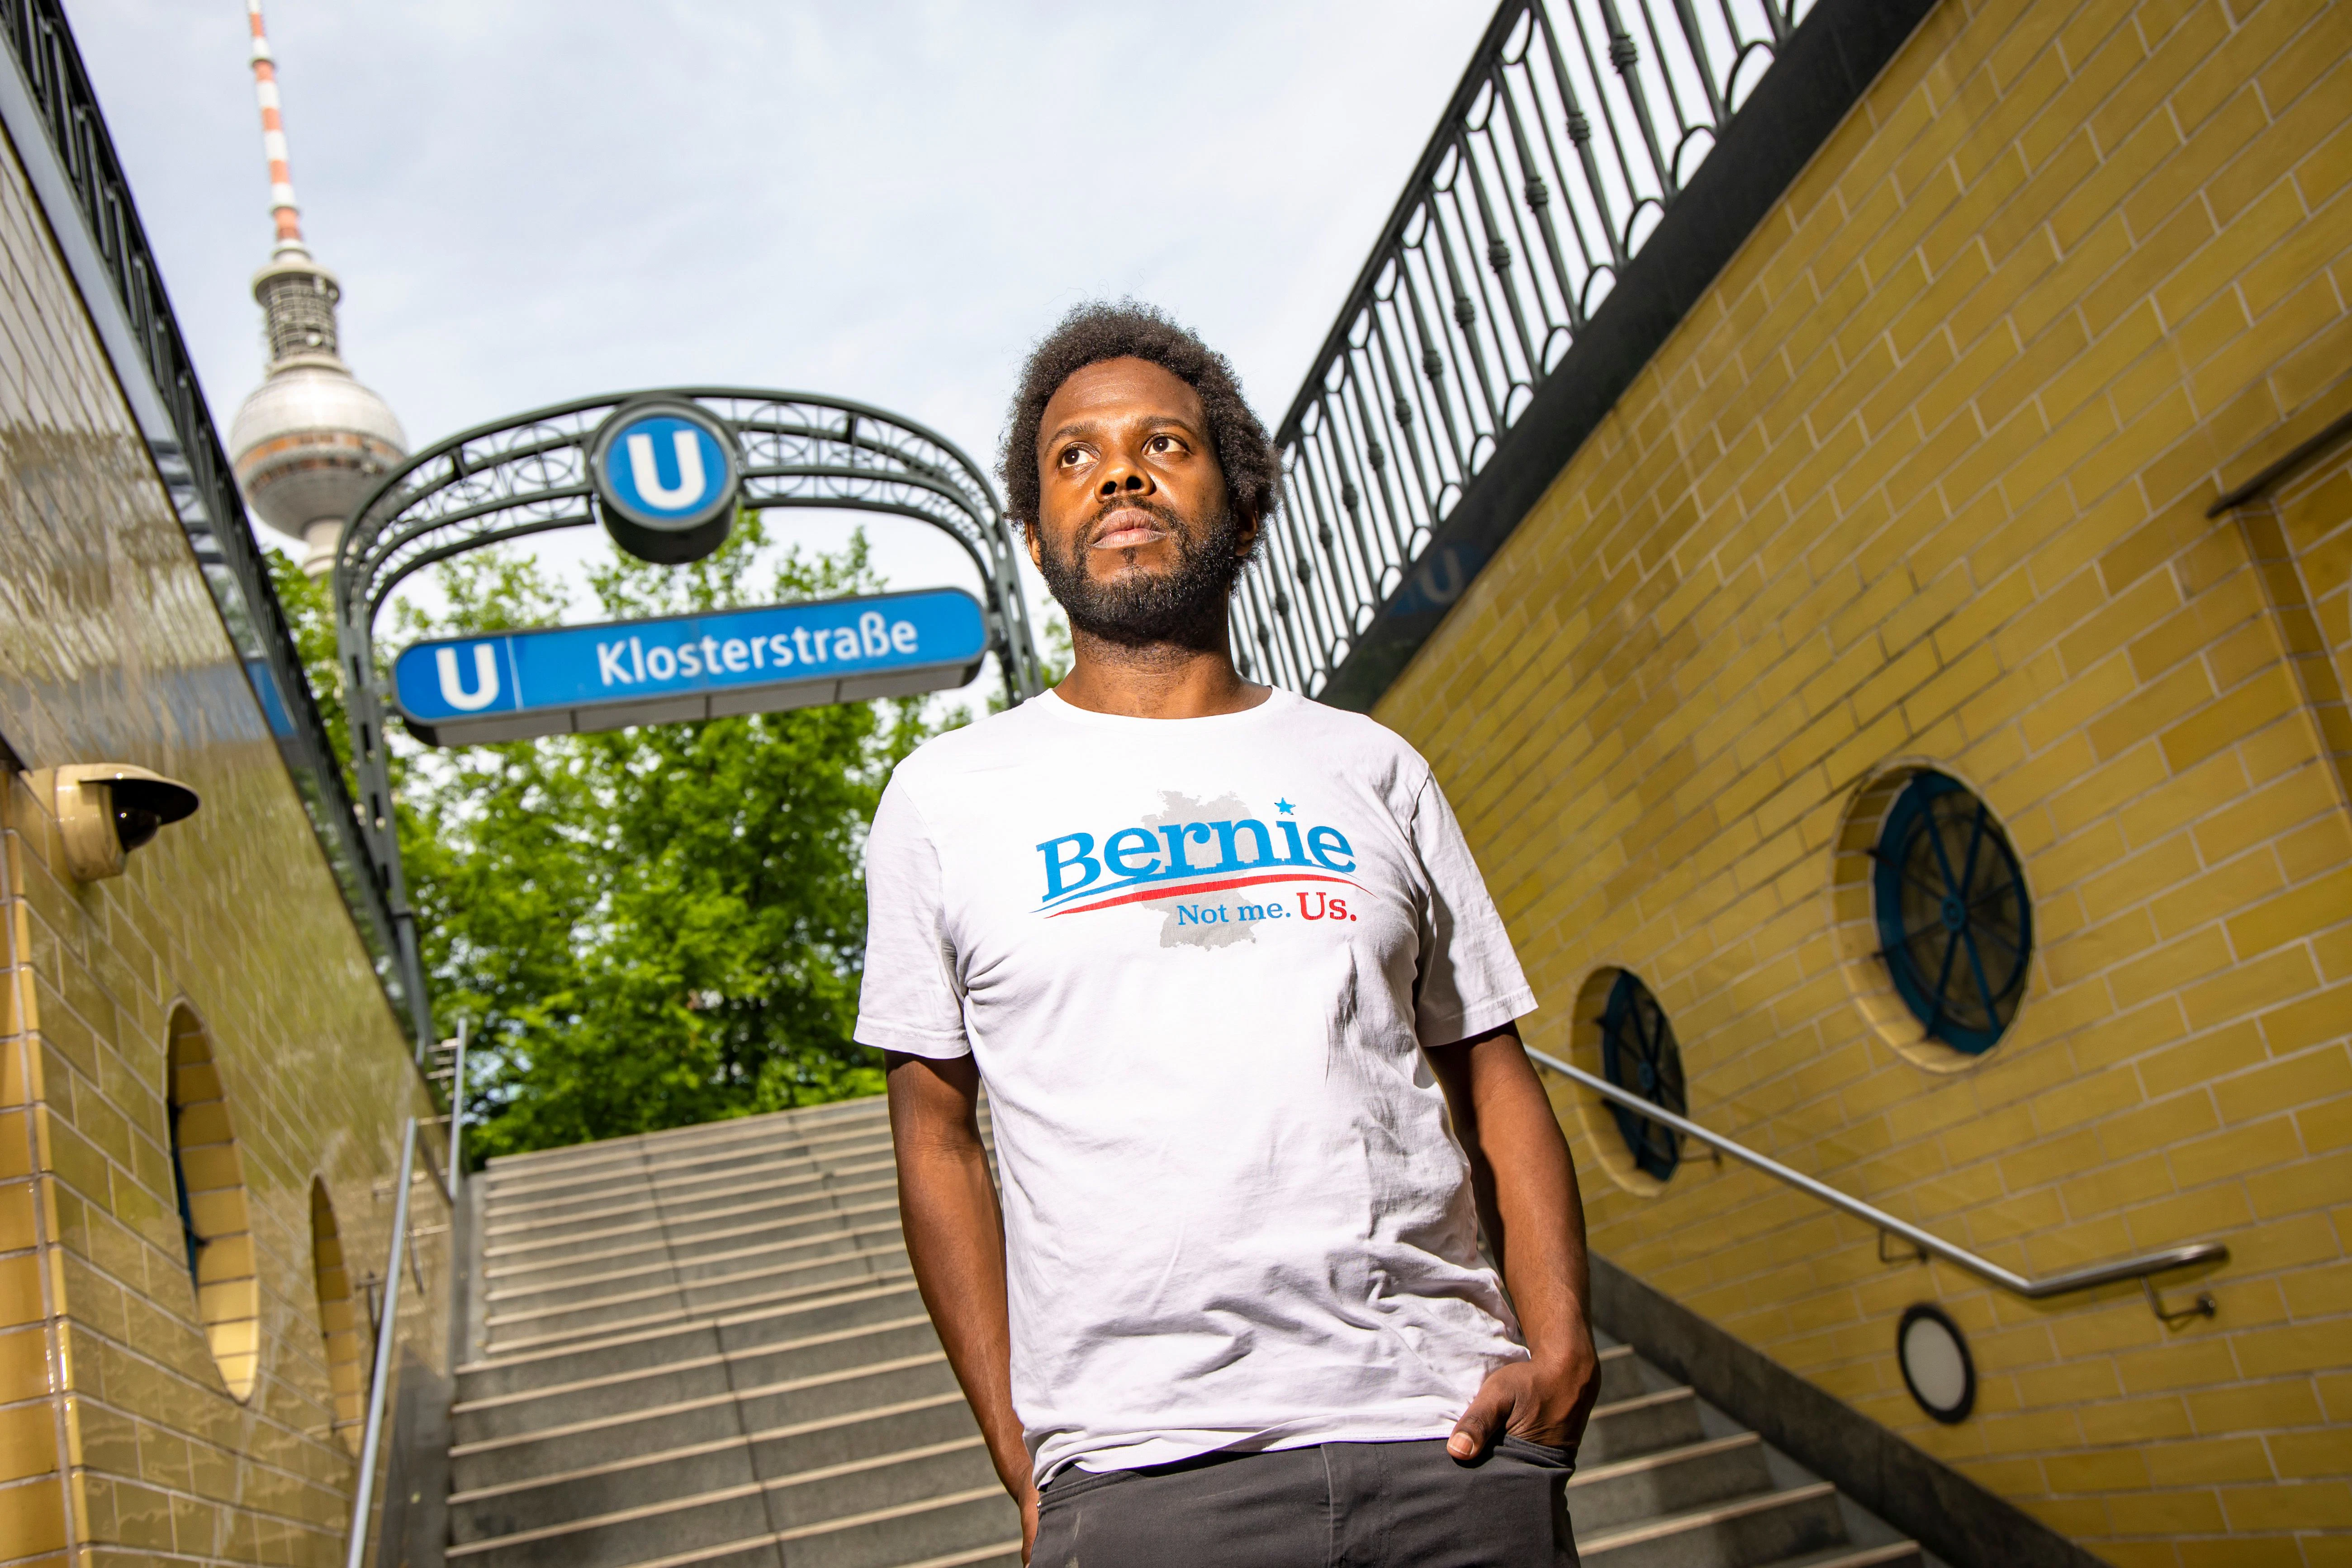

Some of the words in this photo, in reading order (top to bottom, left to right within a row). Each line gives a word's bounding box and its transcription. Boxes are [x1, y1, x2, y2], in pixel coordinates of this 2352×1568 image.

[627, 429, 707, 510] U
[436, 643, 500, 711] U
[597, 611, 917, 686] Klosterstraße
[1035, 797, 1357, 903] Bernie
[1177, 903, 1229, 926] Not
[1237, 902, 1291, 921] me.
[1296, 892, 1357, 922] Us.
